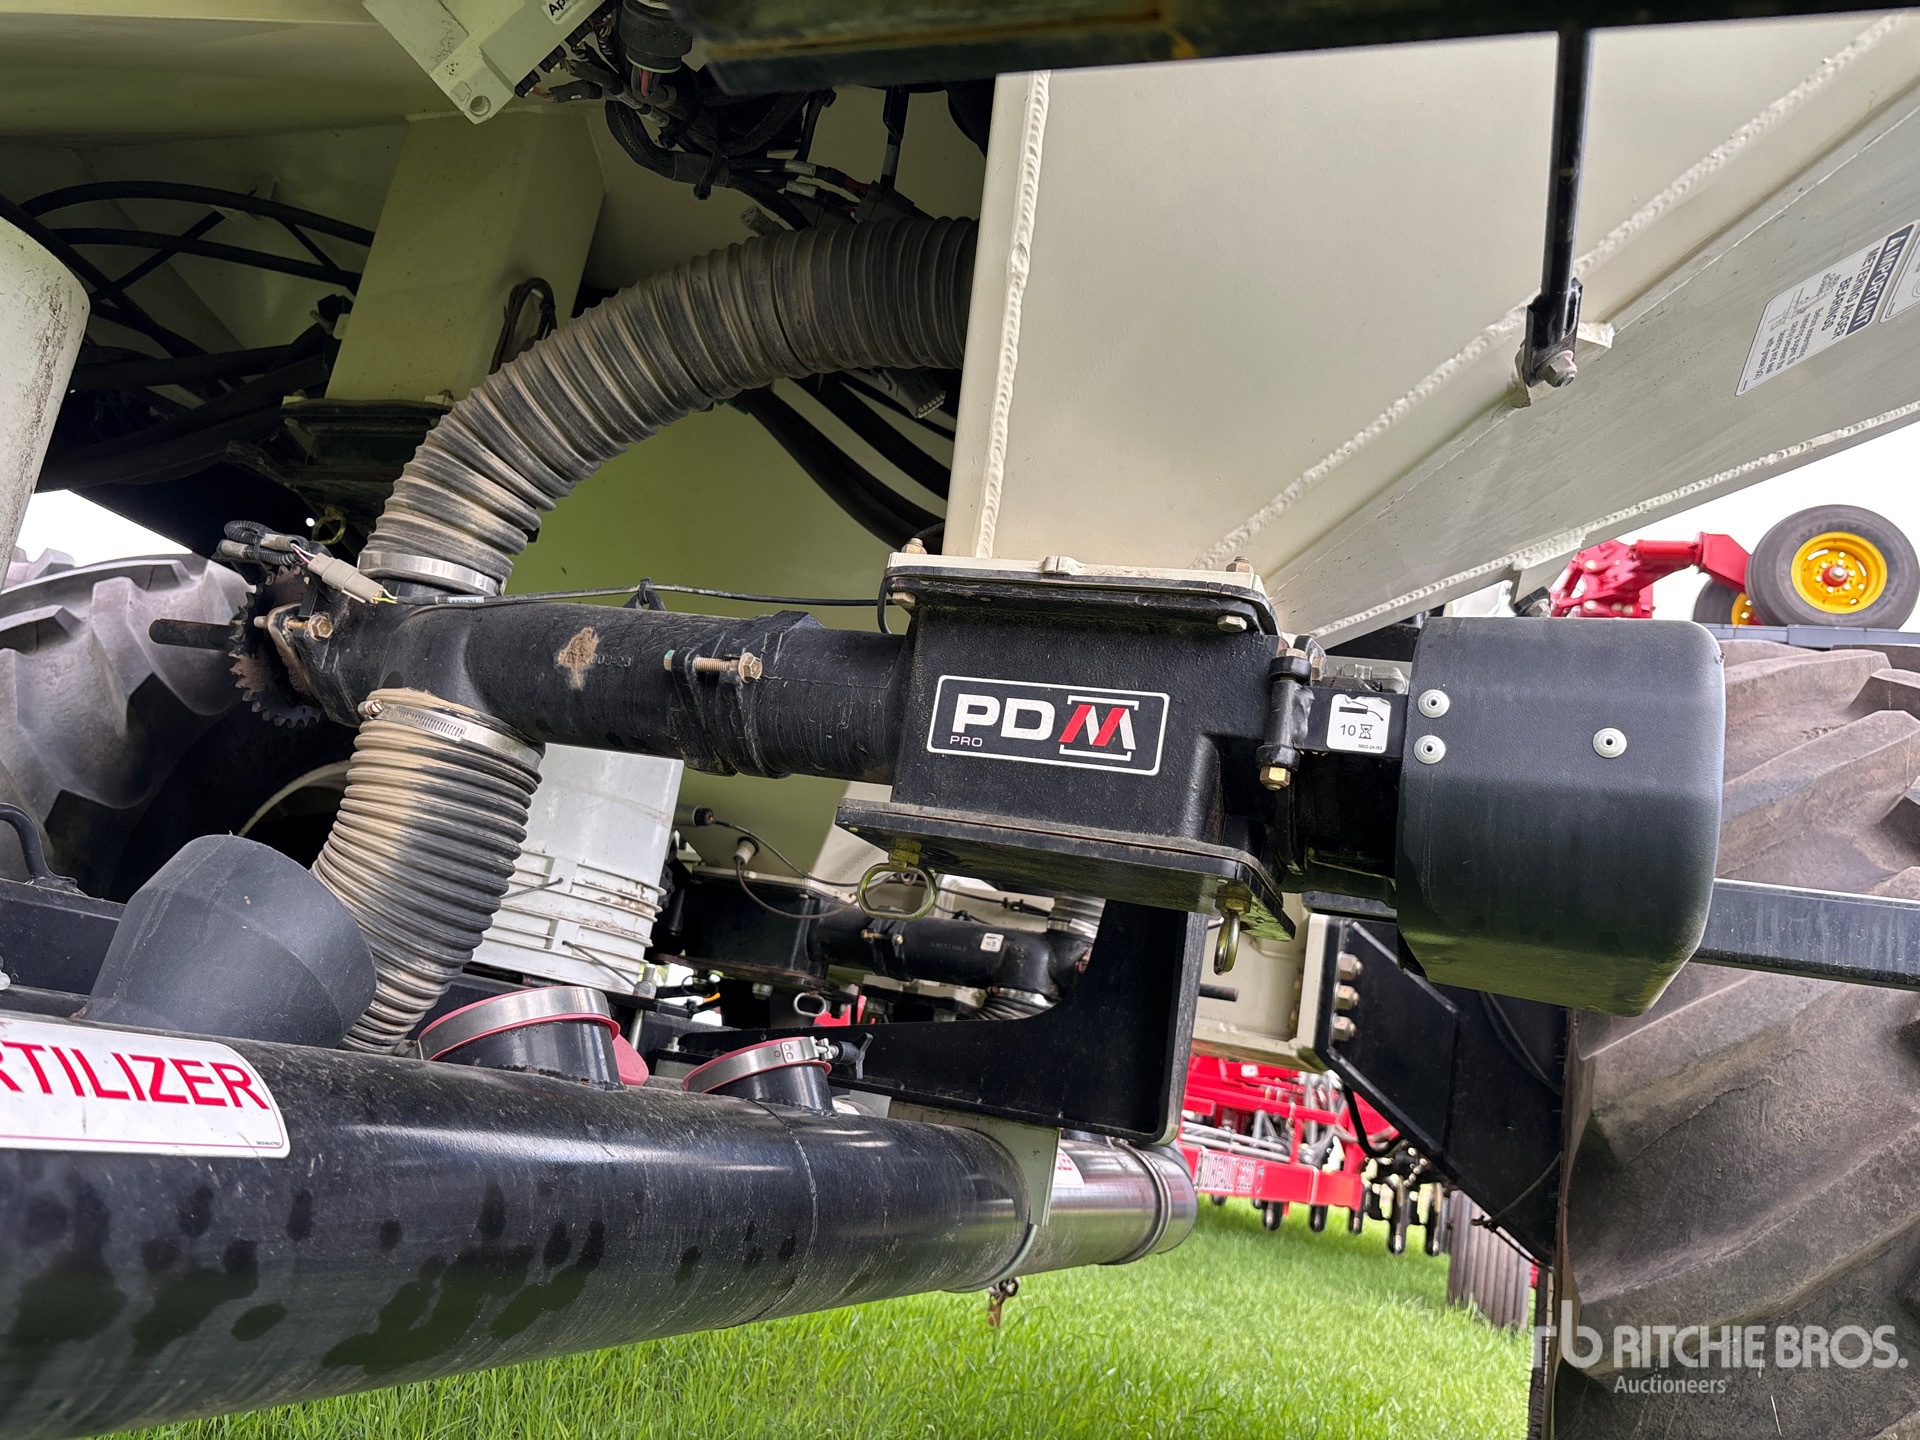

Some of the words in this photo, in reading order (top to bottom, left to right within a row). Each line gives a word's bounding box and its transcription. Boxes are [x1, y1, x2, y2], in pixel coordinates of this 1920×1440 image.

[1846, 246, 1881, 304] METERING
[1853, 245, 1902, 328] IMPORTANT
[1821, 276, 1853, 331] BEARINGS
[1831, 302, 1857, 340] AUGER
[949, 734, 983, 748] PRO
[952, 693, 1137, 750] PDM
[1340, 724, 1357, 737] 10
